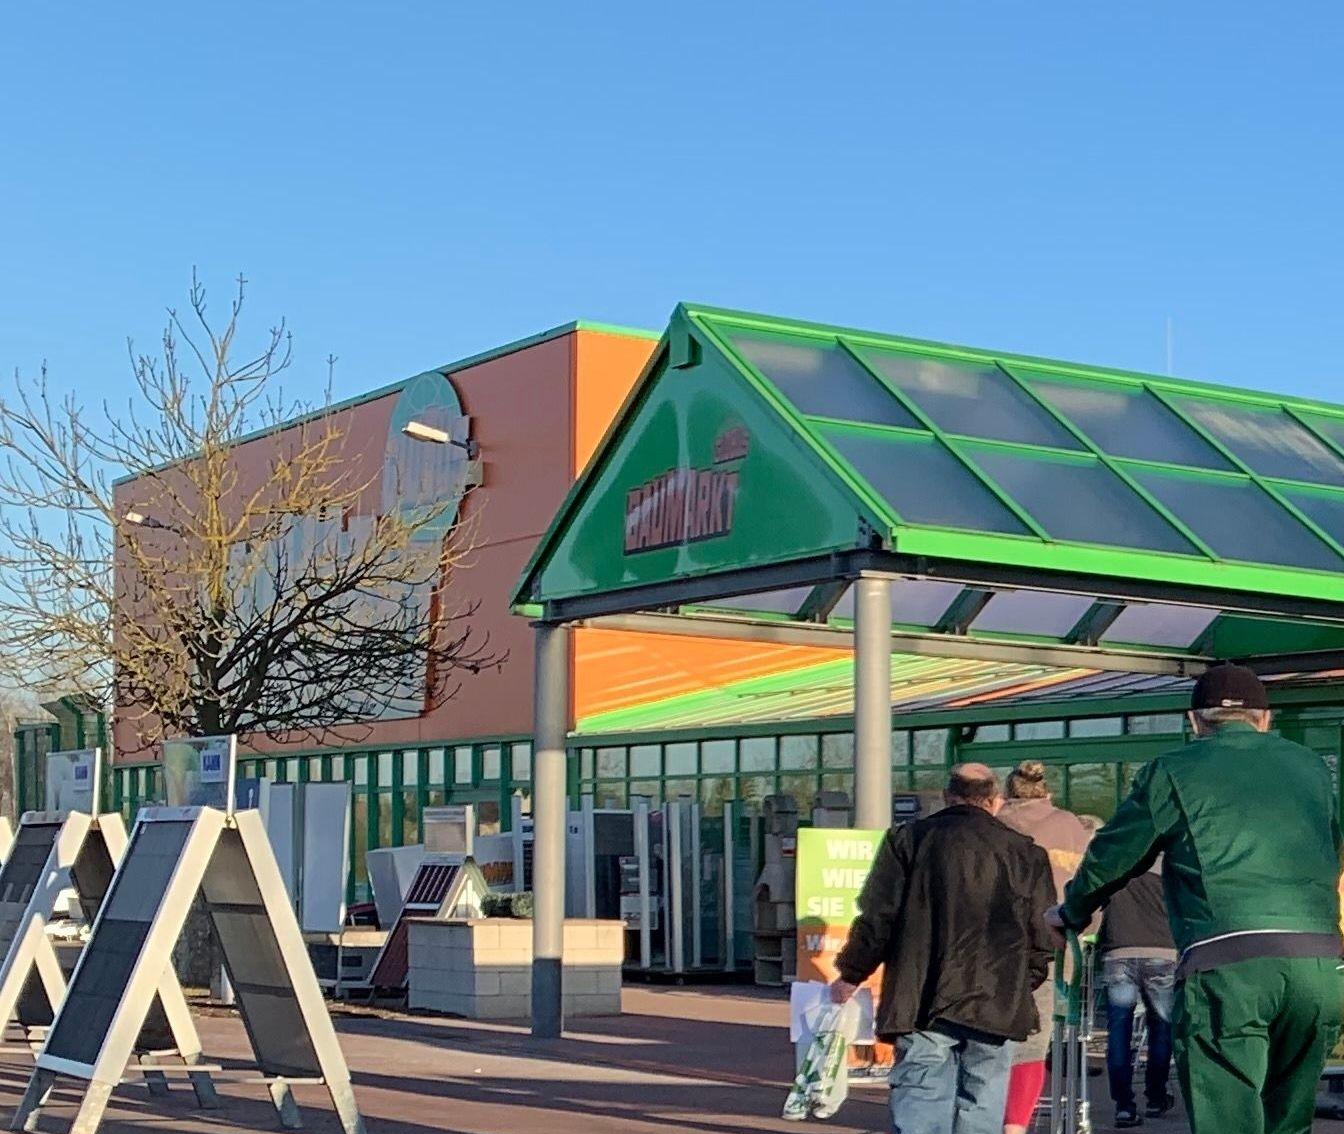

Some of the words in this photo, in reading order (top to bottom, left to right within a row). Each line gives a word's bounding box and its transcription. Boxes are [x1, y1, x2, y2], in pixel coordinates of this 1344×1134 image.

[826, 840, 873, 860] WIR
[822, 868, 868, 888] WIE
[807, 896, 844, 917] SIE
